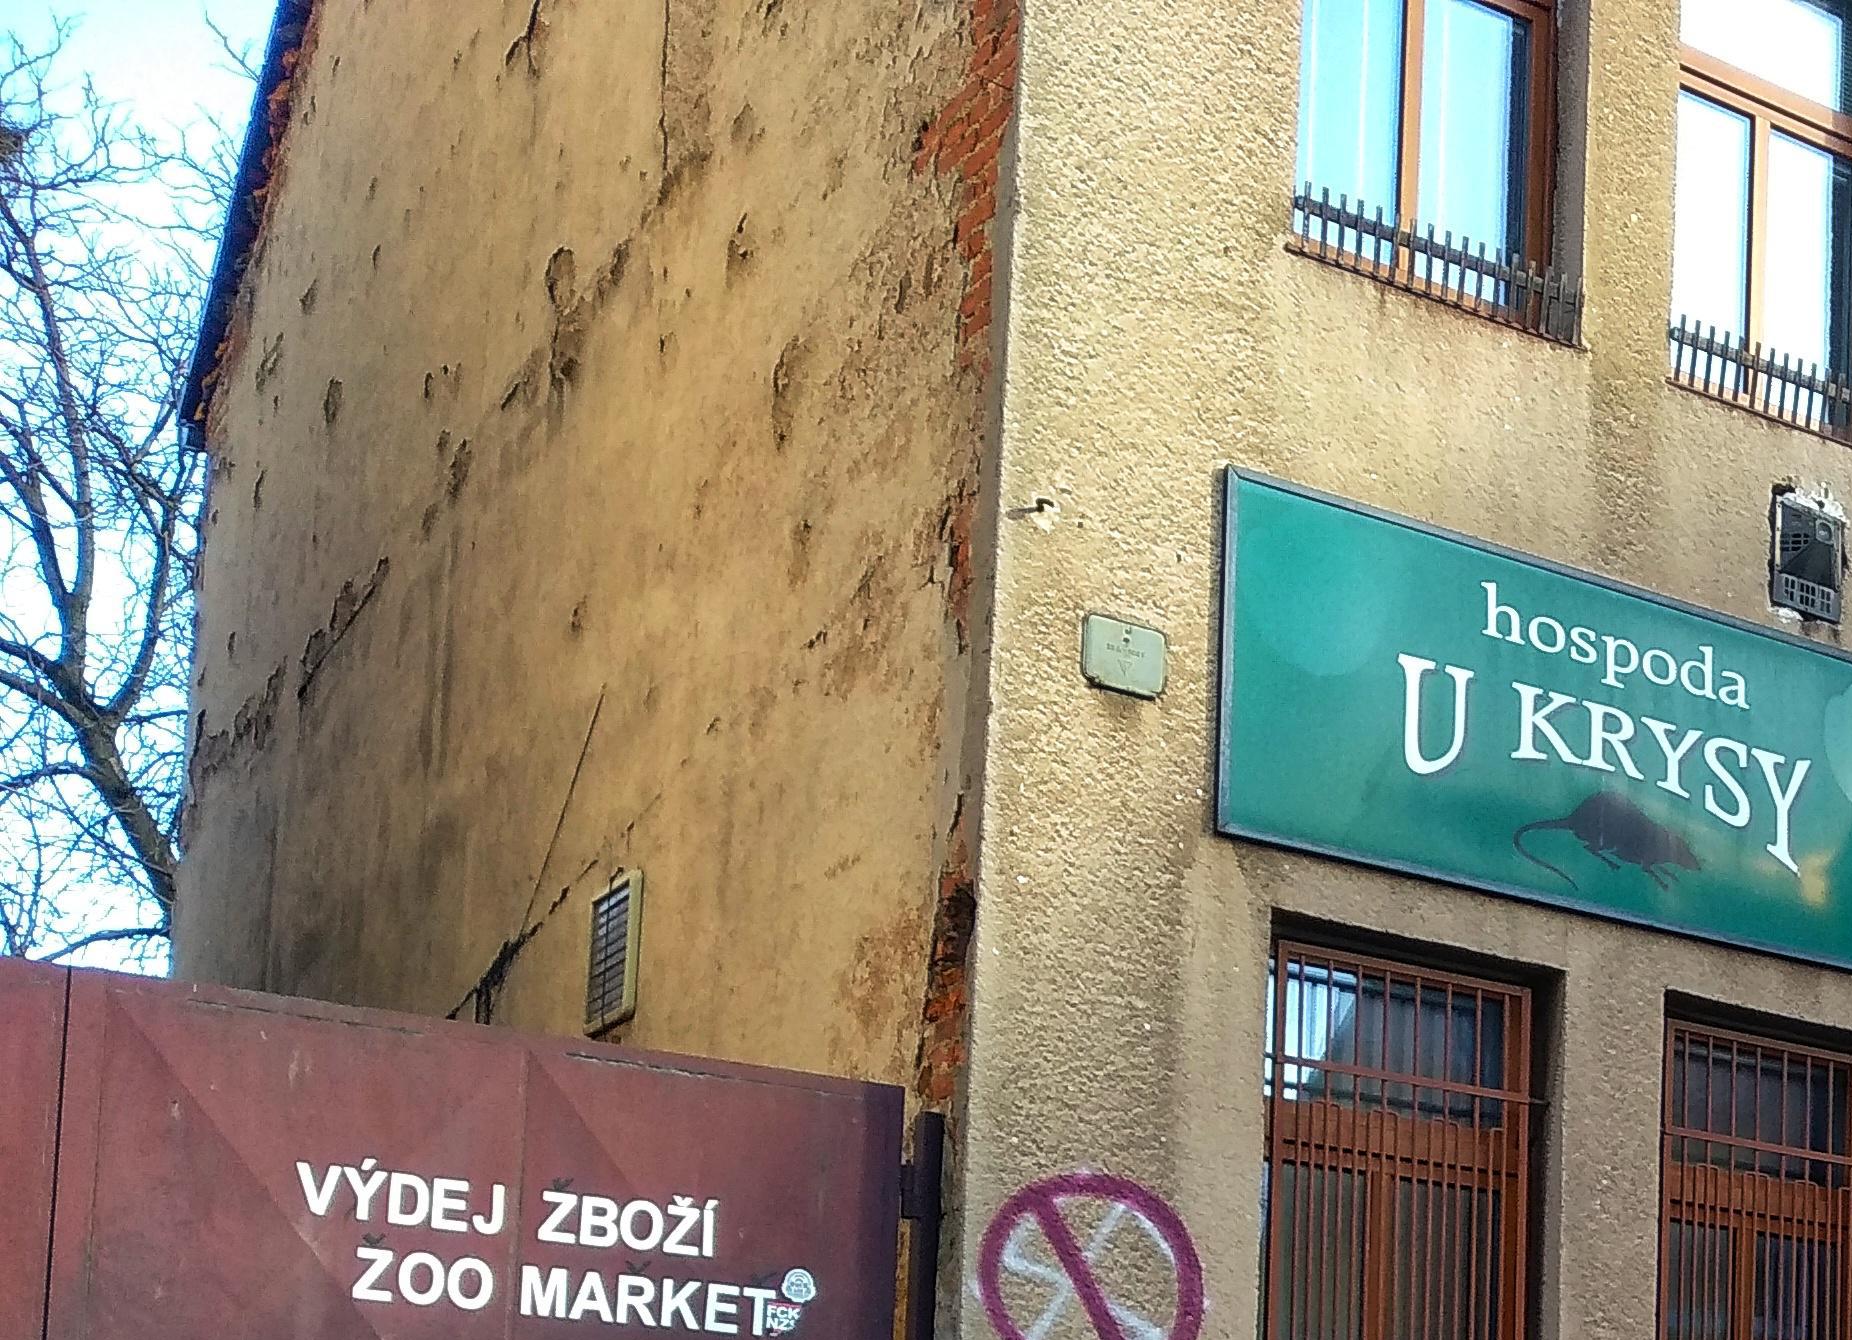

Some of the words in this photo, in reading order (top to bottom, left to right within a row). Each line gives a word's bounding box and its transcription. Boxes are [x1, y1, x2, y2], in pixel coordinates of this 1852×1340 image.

[1481, 581, 1750, 709] hospoda
[1397, 652, 1474, 775] U
[1510, 680, 1812, 876] KRYSY
[296, 1157, 506, 1236] VÝDEJ
[537, 1190, 720, 1258] ZBOŽÍ
[351, 1247, 495, 1311] ZOO
[519, 1265, 778, 1337] MARKET
[766, 1304, 801, 1320] FCK
